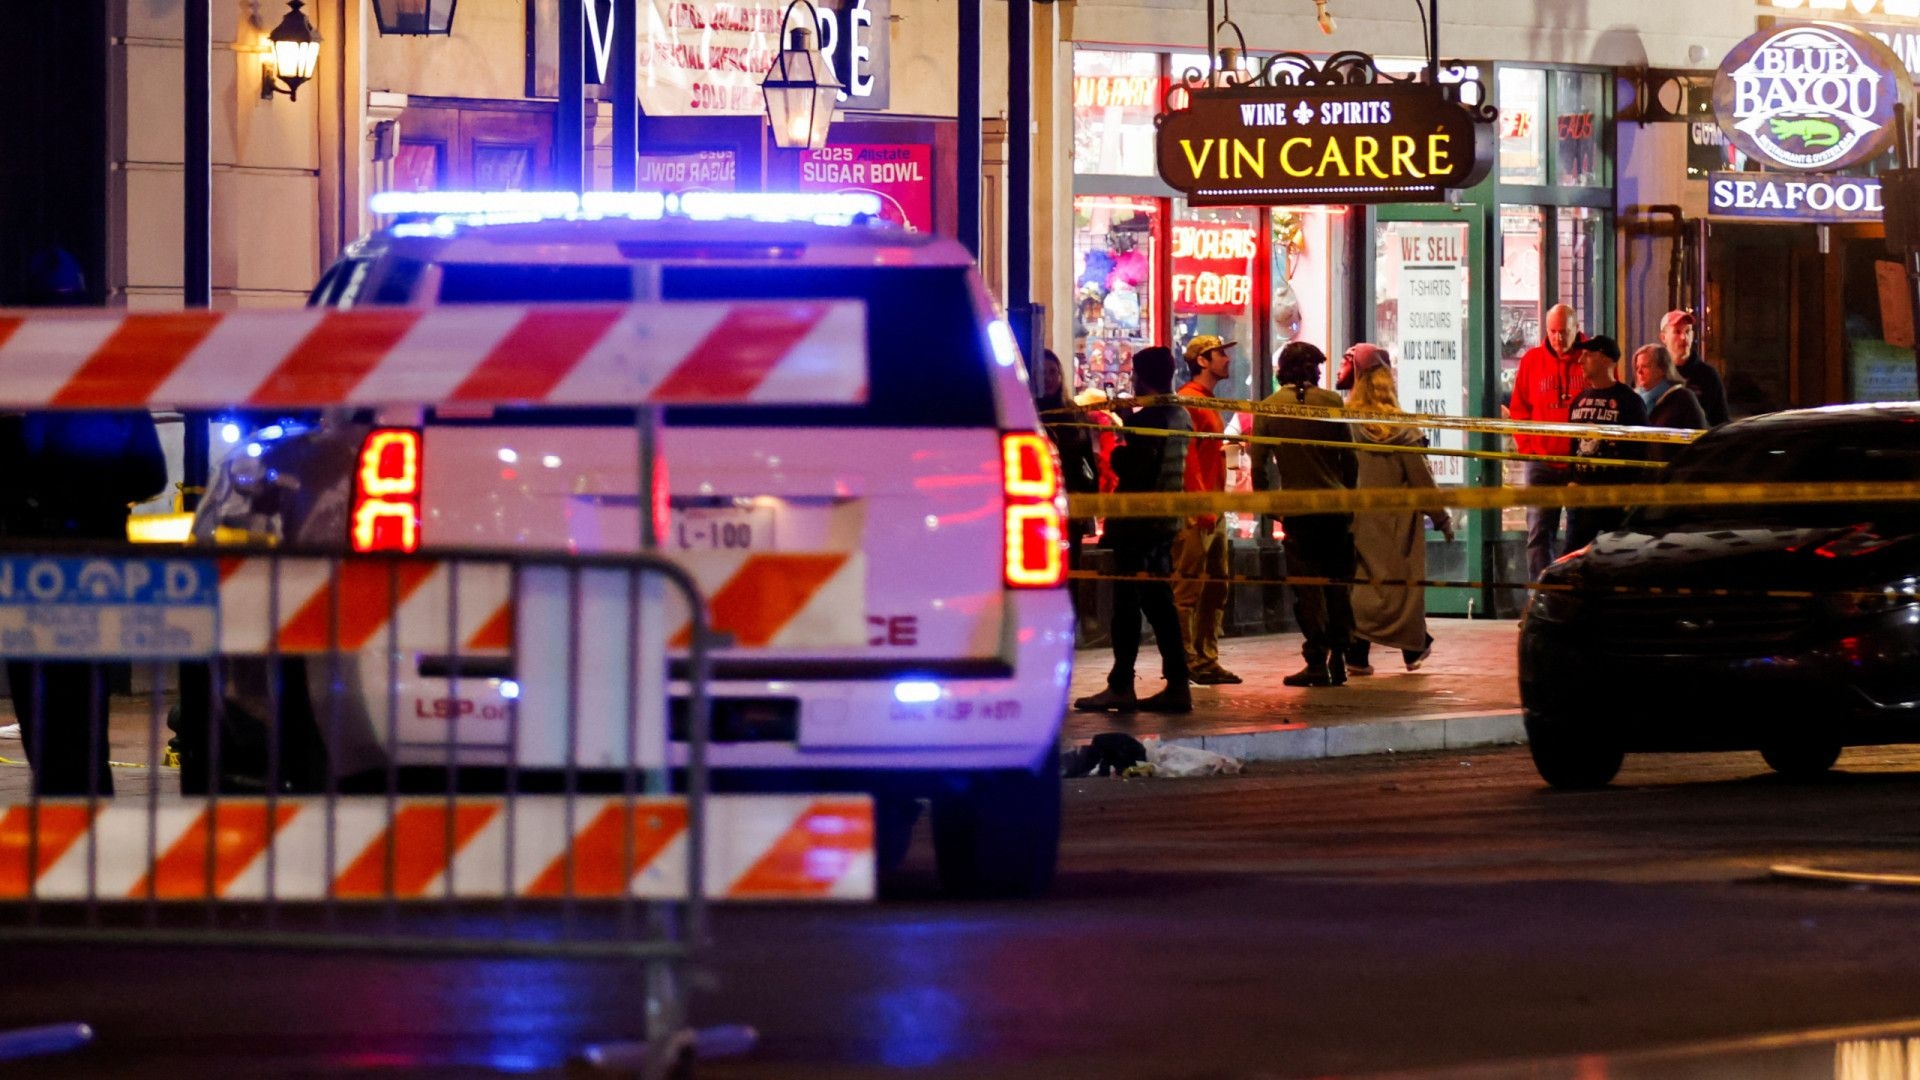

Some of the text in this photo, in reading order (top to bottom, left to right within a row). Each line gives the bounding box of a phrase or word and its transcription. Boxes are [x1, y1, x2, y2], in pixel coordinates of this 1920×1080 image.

[1764, 48, 1849, 74] BLUE
[691, 83, 726, 109] SOLD
[1732, 77, 1878, 118] BAYOU
[1241, 101, 1391, 126] WINE SPIRITS
[1692, 122, 1730, 145] GUM
[812, 148, 911, 161] 2025 Allstate
[1180, 126, 1453, 179] VIN CARRÉ
[803, 161, 924, 183] SUGAR BOWL
[1401, 236, 1458, 261] WE SELL
[1410, 279, 1451, 296] T-SHIRTS
[1404, 340, 1456, 360] KID'S CLOTHING
[1419, 370, 1442, 389] HATS
[1415, 399, 1446, 416] MASKS
[1597, 408, 1619, 422] LIST
